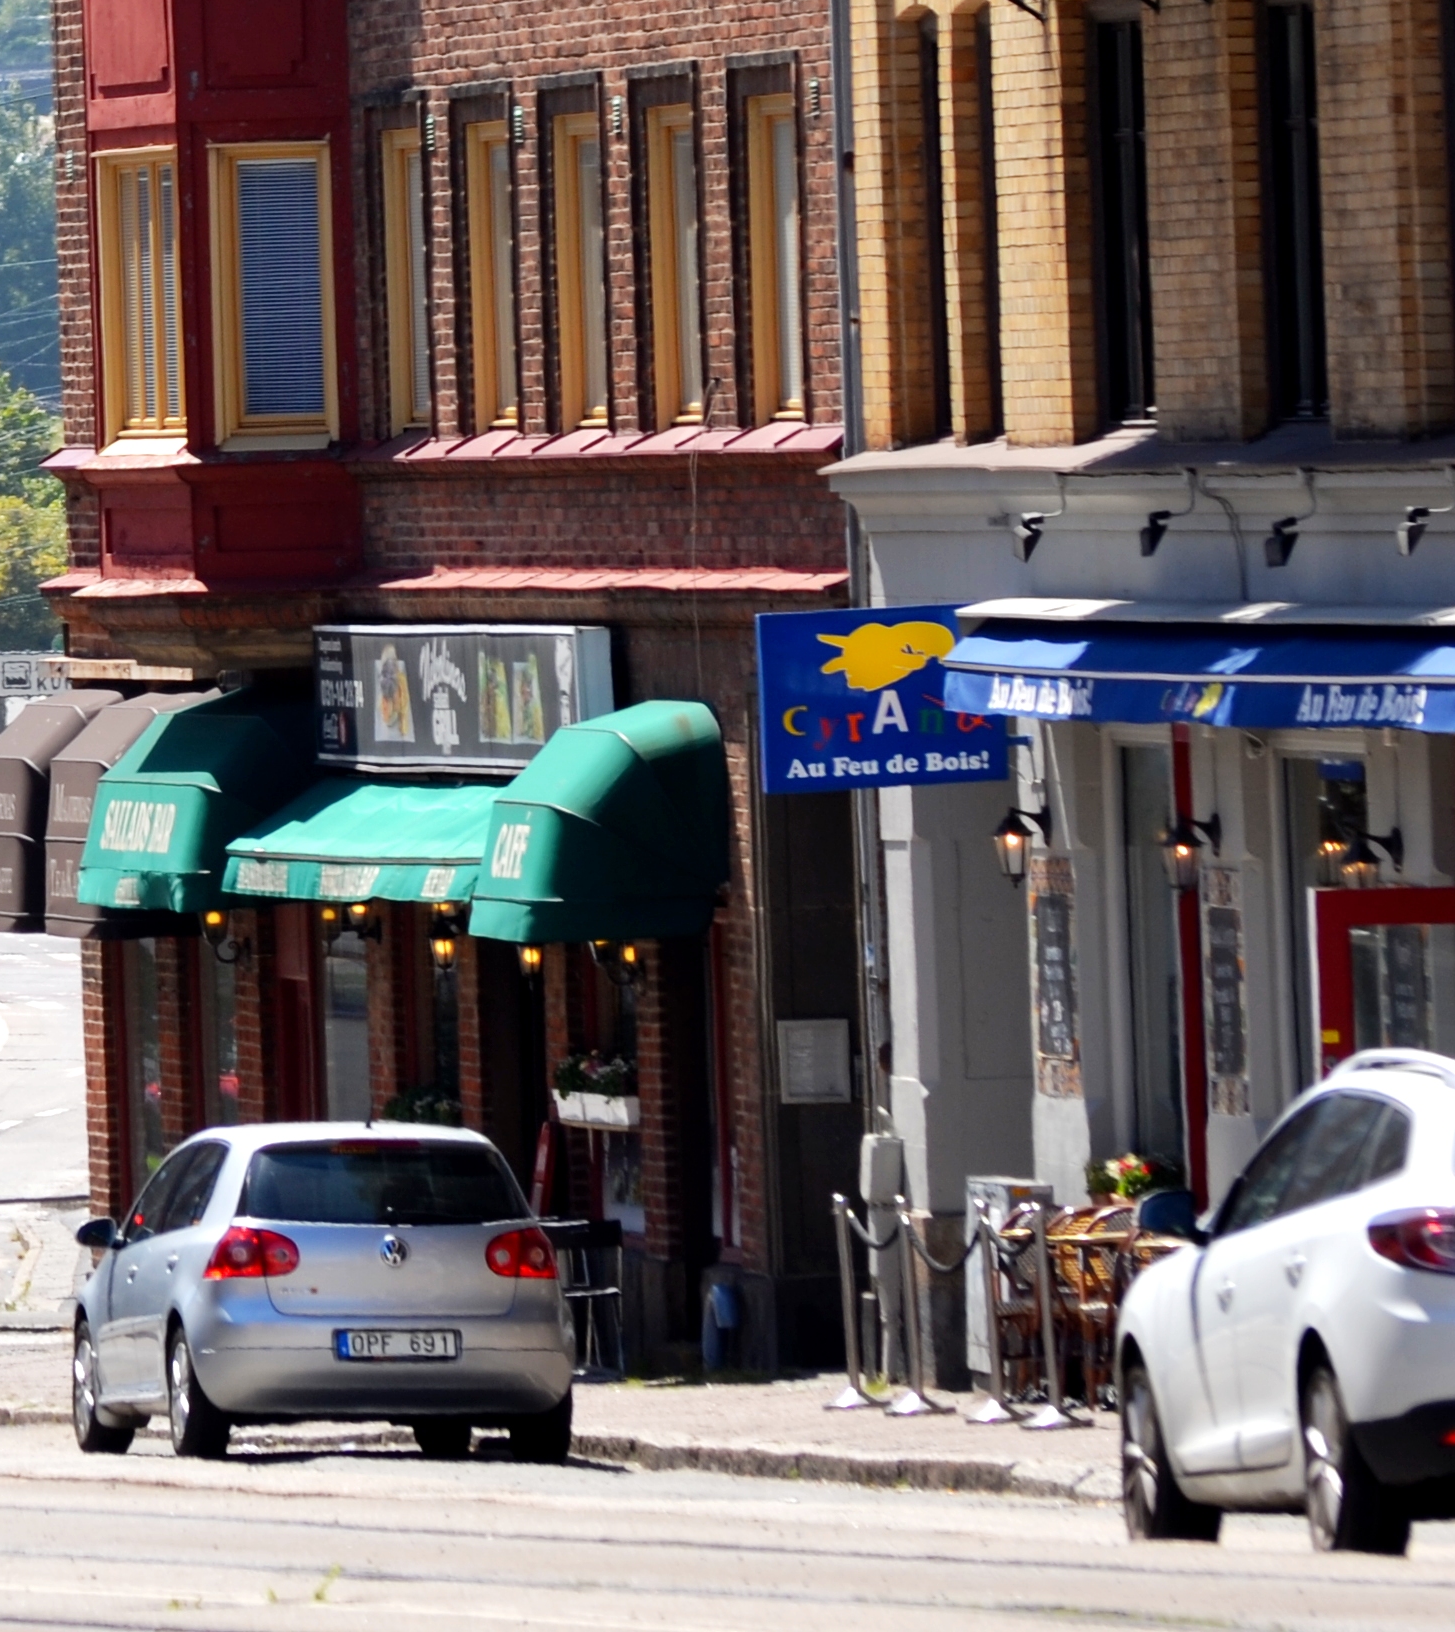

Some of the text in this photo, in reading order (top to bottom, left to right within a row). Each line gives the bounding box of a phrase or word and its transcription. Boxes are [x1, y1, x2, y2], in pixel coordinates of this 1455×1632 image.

[987, 673, 1010, 709] Au
[1007, 674, 1037, 712] Feu
[1036, 678, 1057, 714] de
[1296, 684, 1324, 722] Au
[1324, 684, 1356, 722] Feu
[1354, 685, 1379, 721] de
[786, 750, 990, 778] Au Feu de Bois!
[100, 800, 176, 853] SALLADS BAR
[351, 1334, 449, 1353] OPF 691
